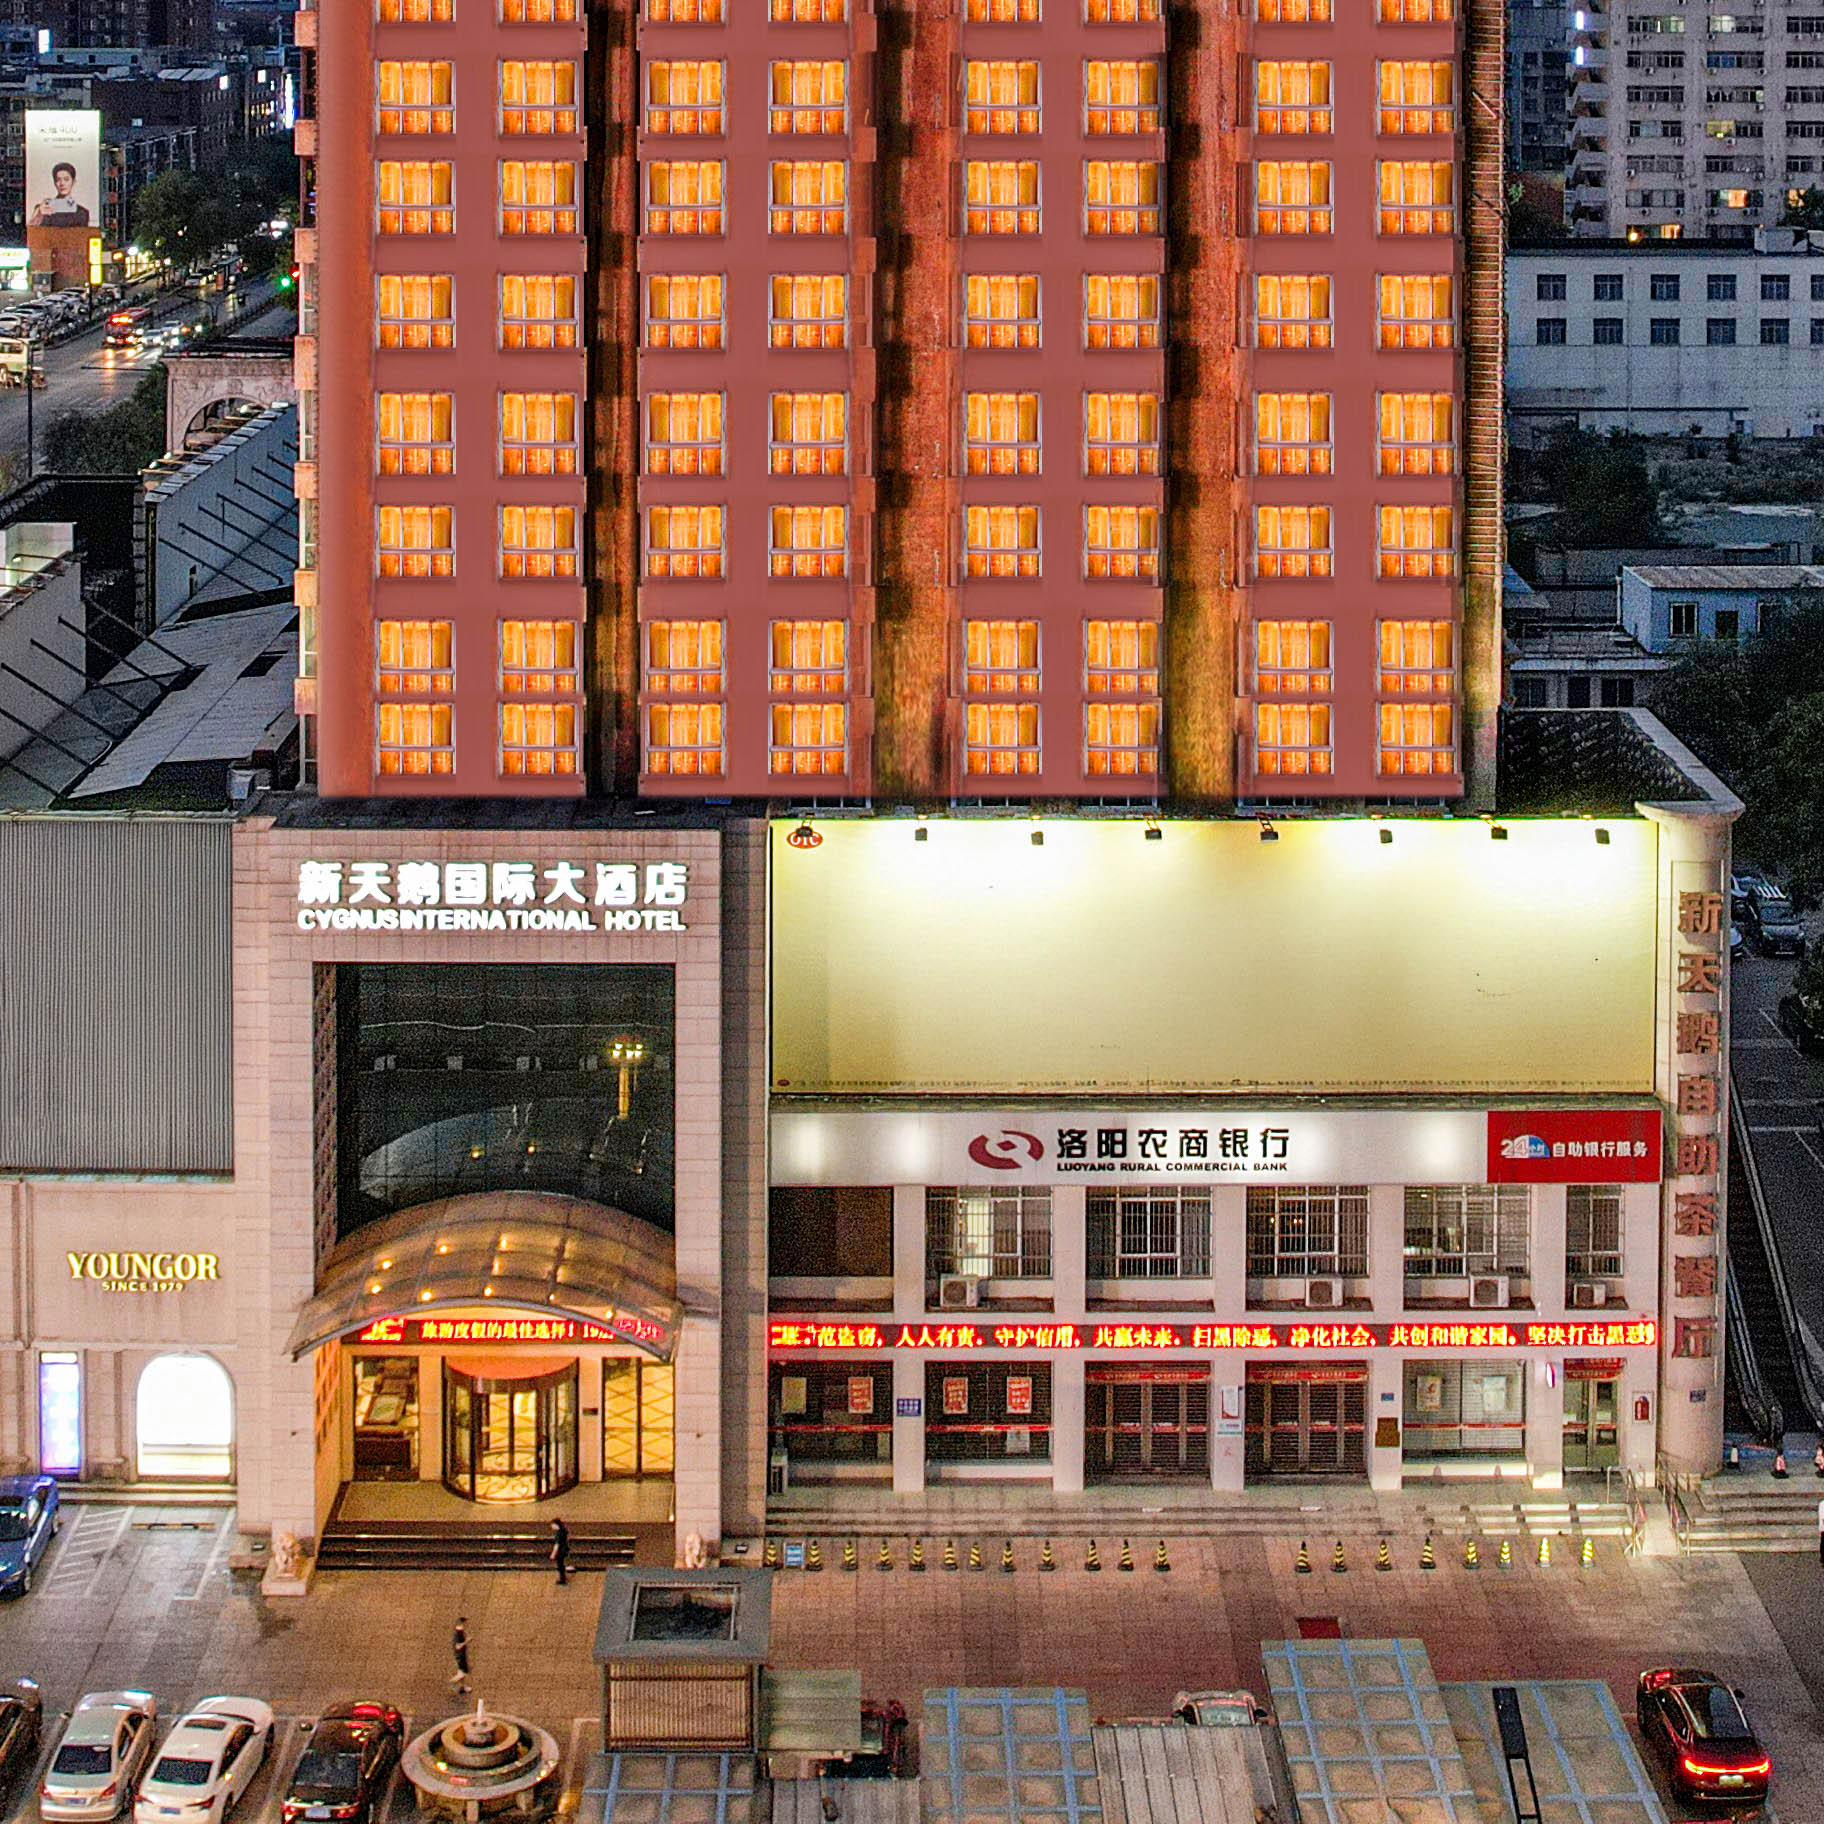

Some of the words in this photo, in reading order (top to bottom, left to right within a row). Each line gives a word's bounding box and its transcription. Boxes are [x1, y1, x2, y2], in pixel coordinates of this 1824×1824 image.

[297, 860, 688, 905] 新天鹅国际大酒店
[604, 910, 687, 931] HOTEL
[1056, 1128, 1290, 1159] 洛阳农商银行
[1057, 1162, 1116, 1172] LUOYANG
[1120, 1162, 1161, 1172] RURAL
[1166, 1162, 1248, 1172] COMMERCIAL
[1253, 1162, 1288, 1172] BANK
[66, 1251, 219, 1281] YOUNGOR
[102, 1280, 148, 1292] SINCE
[152, 1281, 183, 1292] 1979
